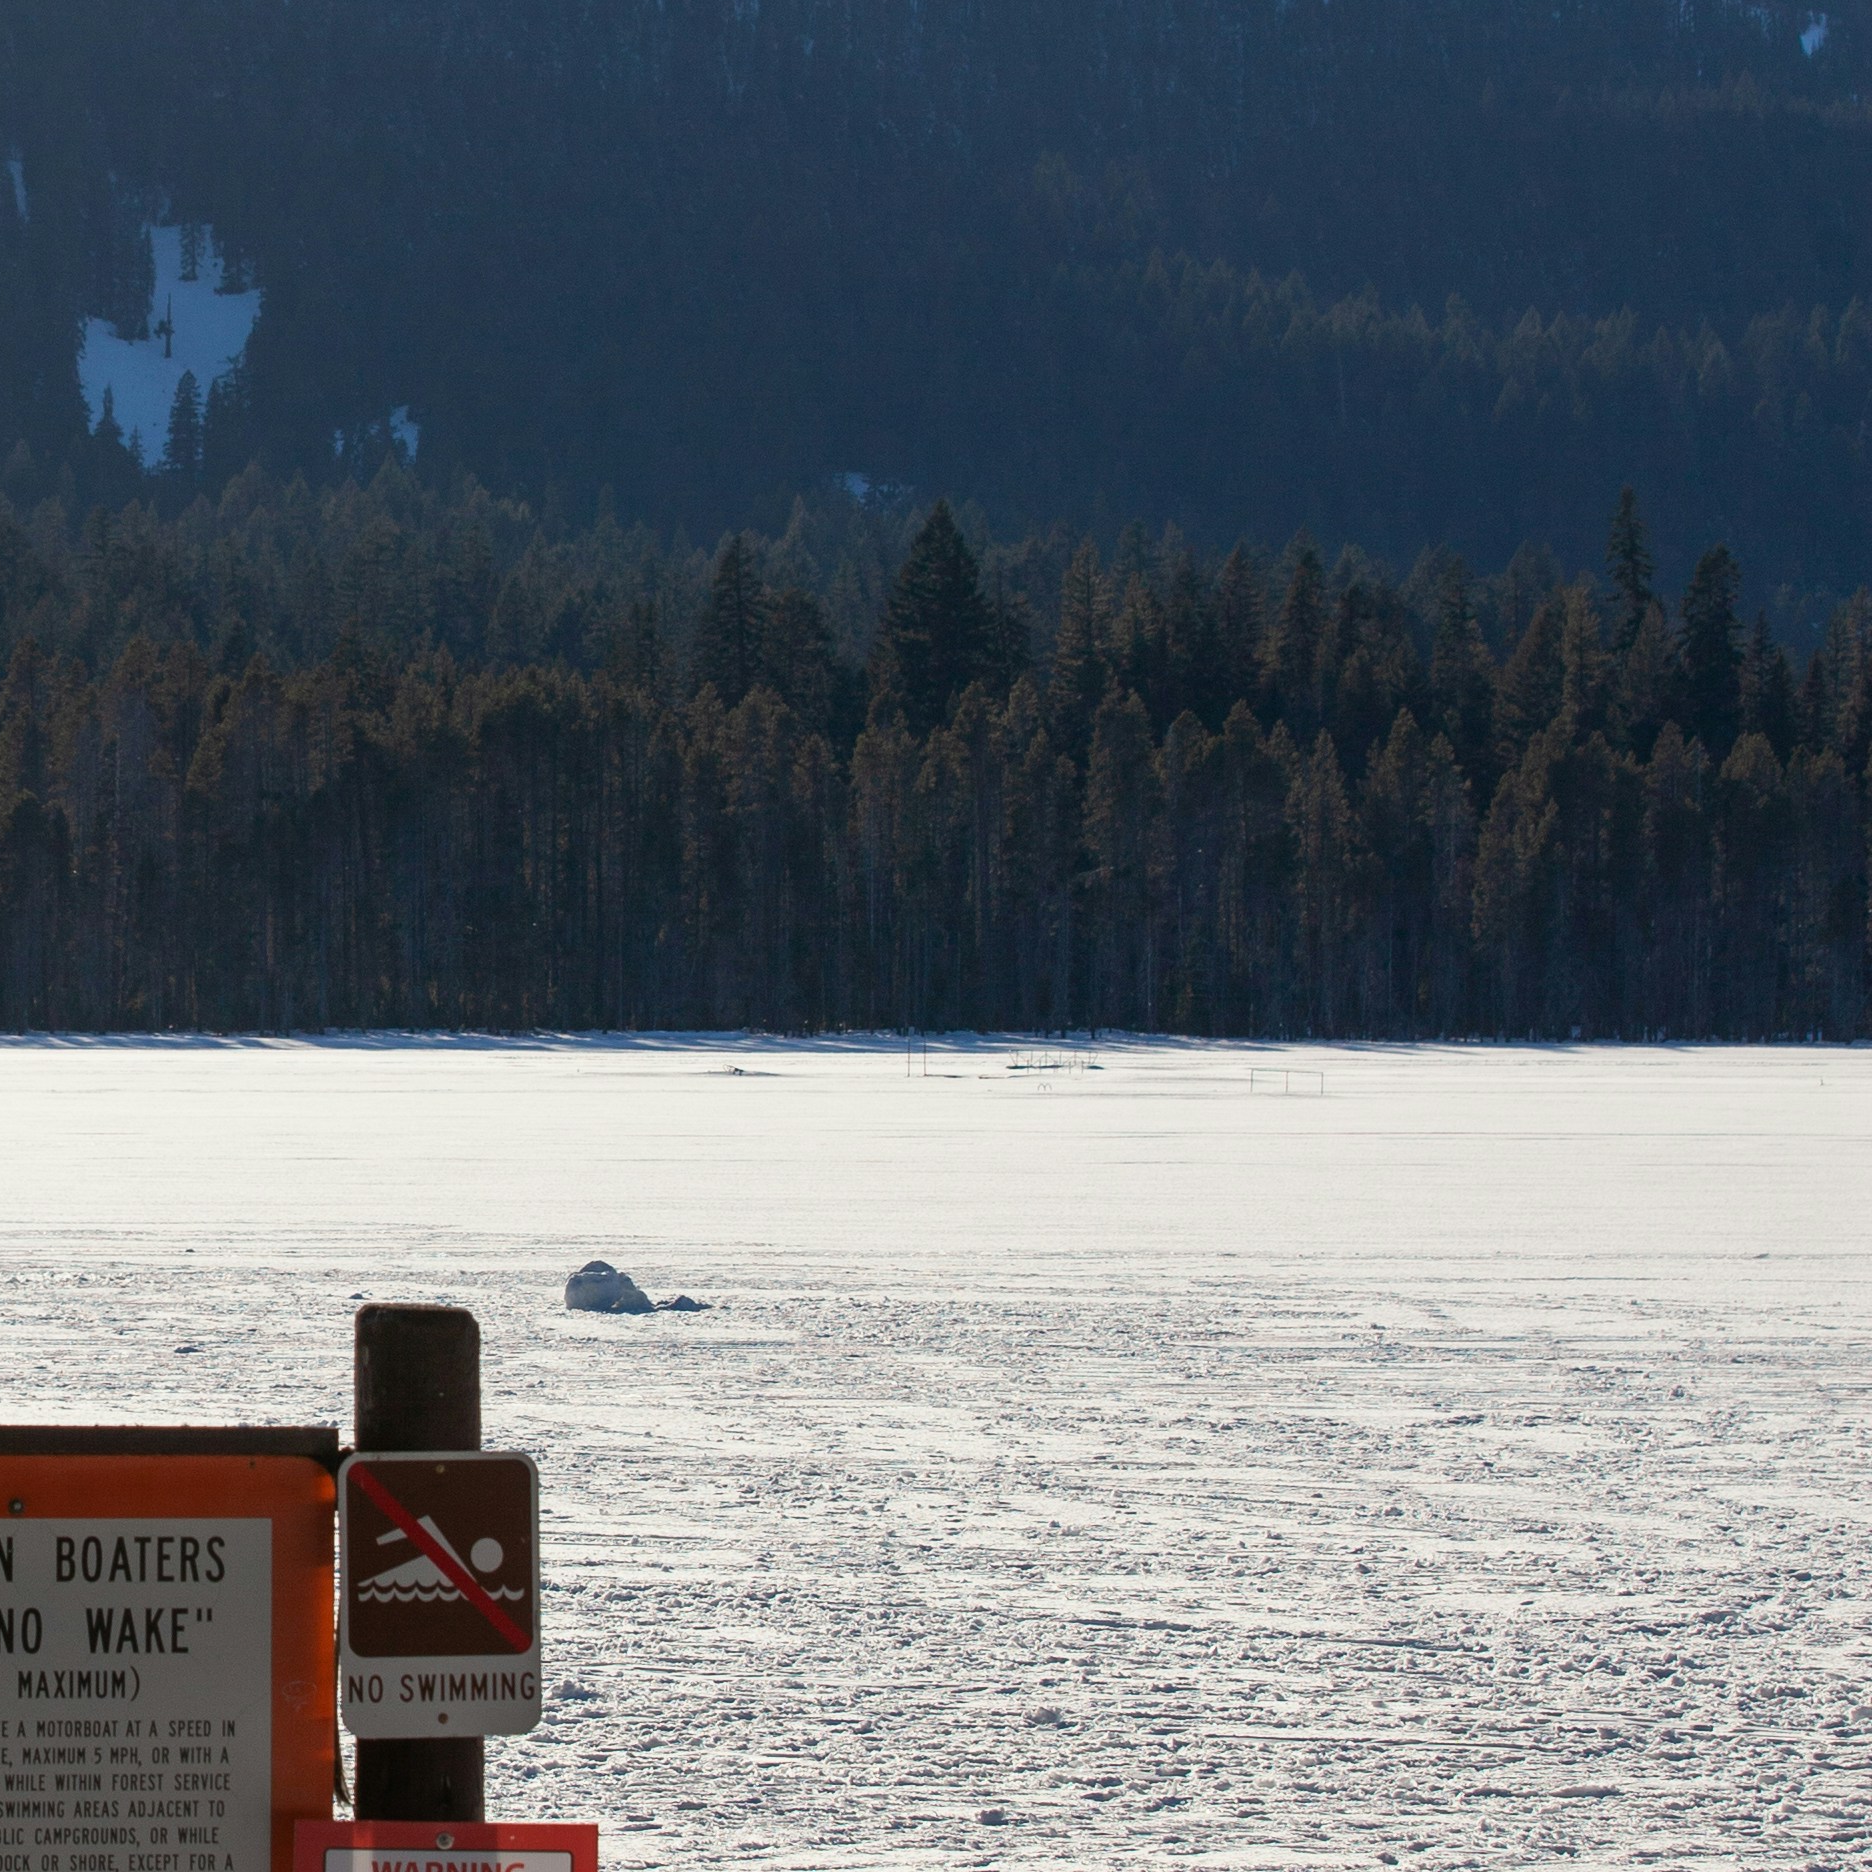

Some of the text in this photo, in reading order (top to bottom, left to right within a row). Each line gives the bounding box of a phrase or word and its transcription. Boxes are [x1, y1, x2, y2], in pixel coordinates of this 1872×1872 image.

[56, 1536, 225, 1582] BOATERS
[85, 1607, 212, 1653] WAKE"
[18, 1667, 140, 1699] MAXIMUM)
[348, 1672, 534, 1703] NO SWIMMING
[16, 1720, 26, 1737] A
[36, 1720, 118, 1737] MOTORBOAT
[125, 1720, 141, 1737] AT
[148, 1720, 158, 1736] A
[168, 1719, 211, 1737] SPEED
[222, 1719, 235, 1736] IN
[22, 1747, 86, 1764] MAXIMUM
[94, 1746, 102, 1764] 5
[110, 1746, 142, 1766] MPH,
[151, 1746, 169, 1763] OR
[179, 1746, 211, 1763] WITH
[220, 1746, 229, 1763] A
[4, 1774, 45, 1791] WHILE
[54, 1774, 101, 1790] WITHIN
[111, 1773, 163, 1790] FOREST
[174, 1773, 230, 1790] SERVICE
